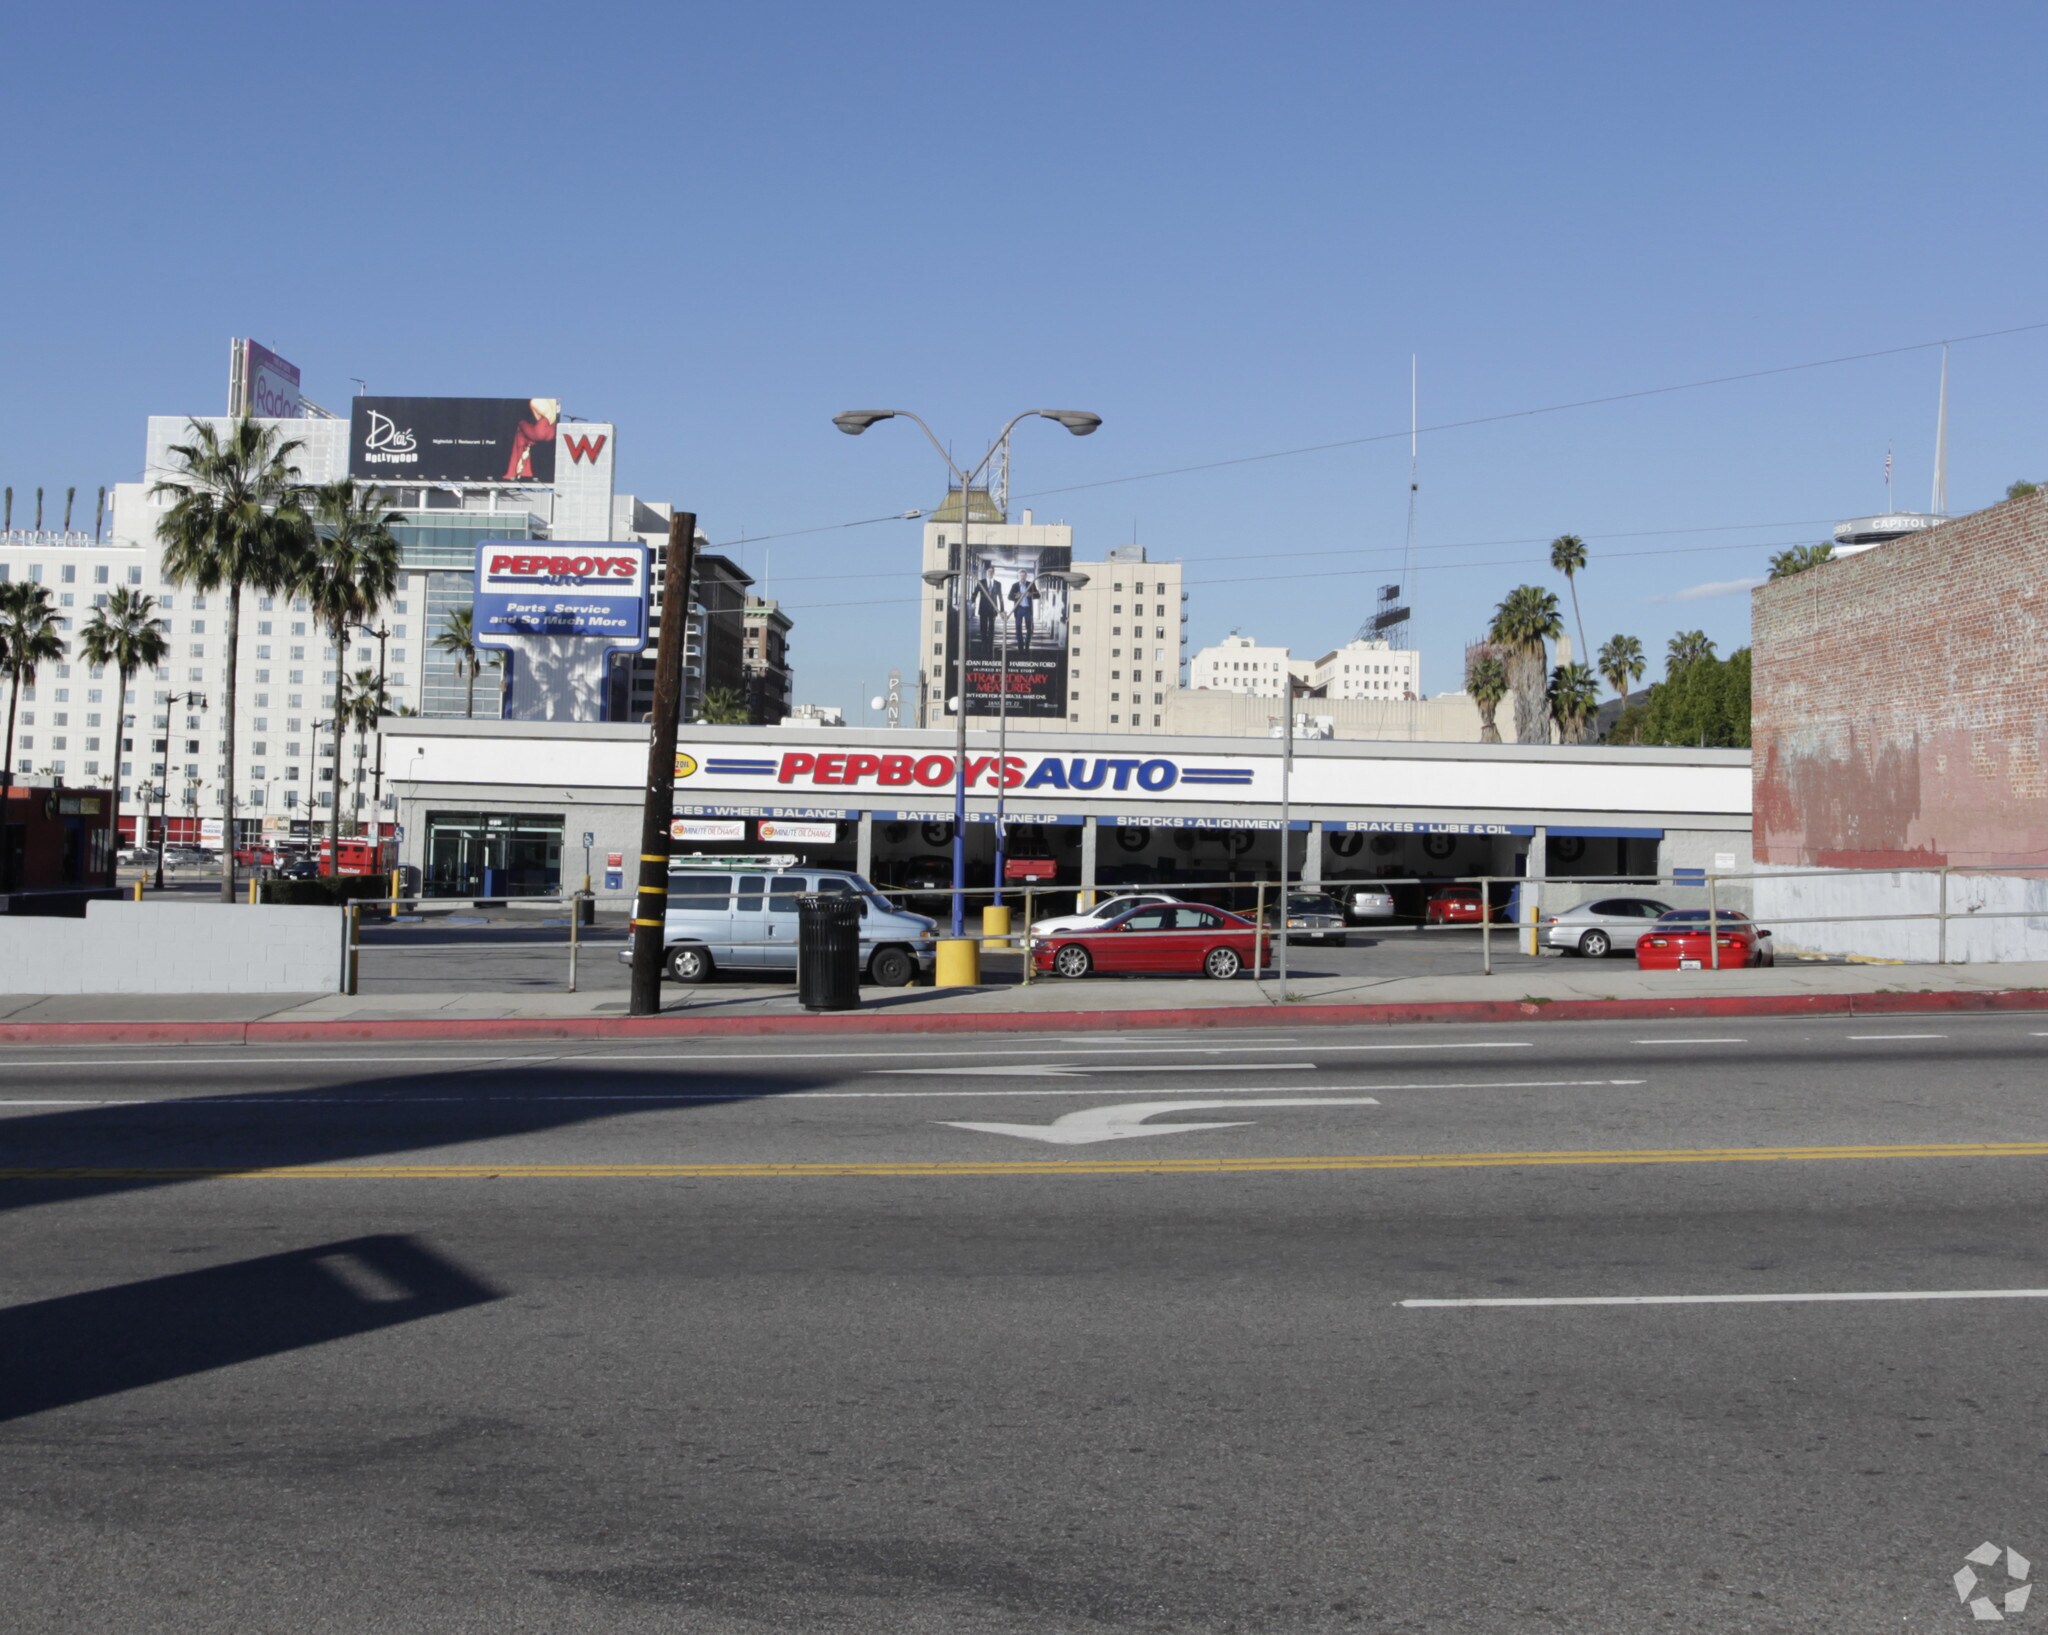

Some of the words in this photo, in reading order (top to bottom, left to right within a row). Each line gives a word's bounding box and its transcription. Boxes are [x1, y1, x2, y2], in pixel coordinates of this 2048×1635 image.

[365, 409, 417, 453] Drai's
[562, 433, 607, 465] W
[365, 452, 418, 463] HOLLYWOOD
[1872, 518, 1927, 530] CAPITOL
[489, 555, 638, 576] PEPBOYS
[539, 575, 585, 587] AUTO
[507, 602, 546, 613] Parts
[554, 604, 611, 614] Service
[489, 613, 517, 625] and
[521, 615, 540, 625] So
[544, 615, 585, 626] Much
[588, 616, 627, 627] More
[965, 673, 1048, 684] XTRAODINARY
[976, 682, 1032, 693] MEAURES
[675, 760, 690, 769] ZOIL
[778, 752, 1026, 789] PEPBOYS
[1023, 757, 1180, 792] AUTO
[672, 805, 704, 816] RES
[715, 806, 769, 817] WHEEL
[773, 808, 847, 819] BALANCE
[896, 811, 980, 822] BATTERES
[1116, 816, 1184, 827] SHOCKS
[685, 827, 706, 835] MINUTE
[774, 828, 796, 836] MINUTE
[798, 829, 807, 837] OIL
[807, 829, 832, 838] CHANGE
[1346, 822, 1414, 833] BRAKES
[1429, 824, 1469, 833] LUBE
[1473, 825, 1485, 834] &
[1486, 825, 1511, 835] OIL
[1125, 825, 1142, 847] 5
[1337, 830, 1352, 853] 7
[1430, 833, 1450, 854] 8
